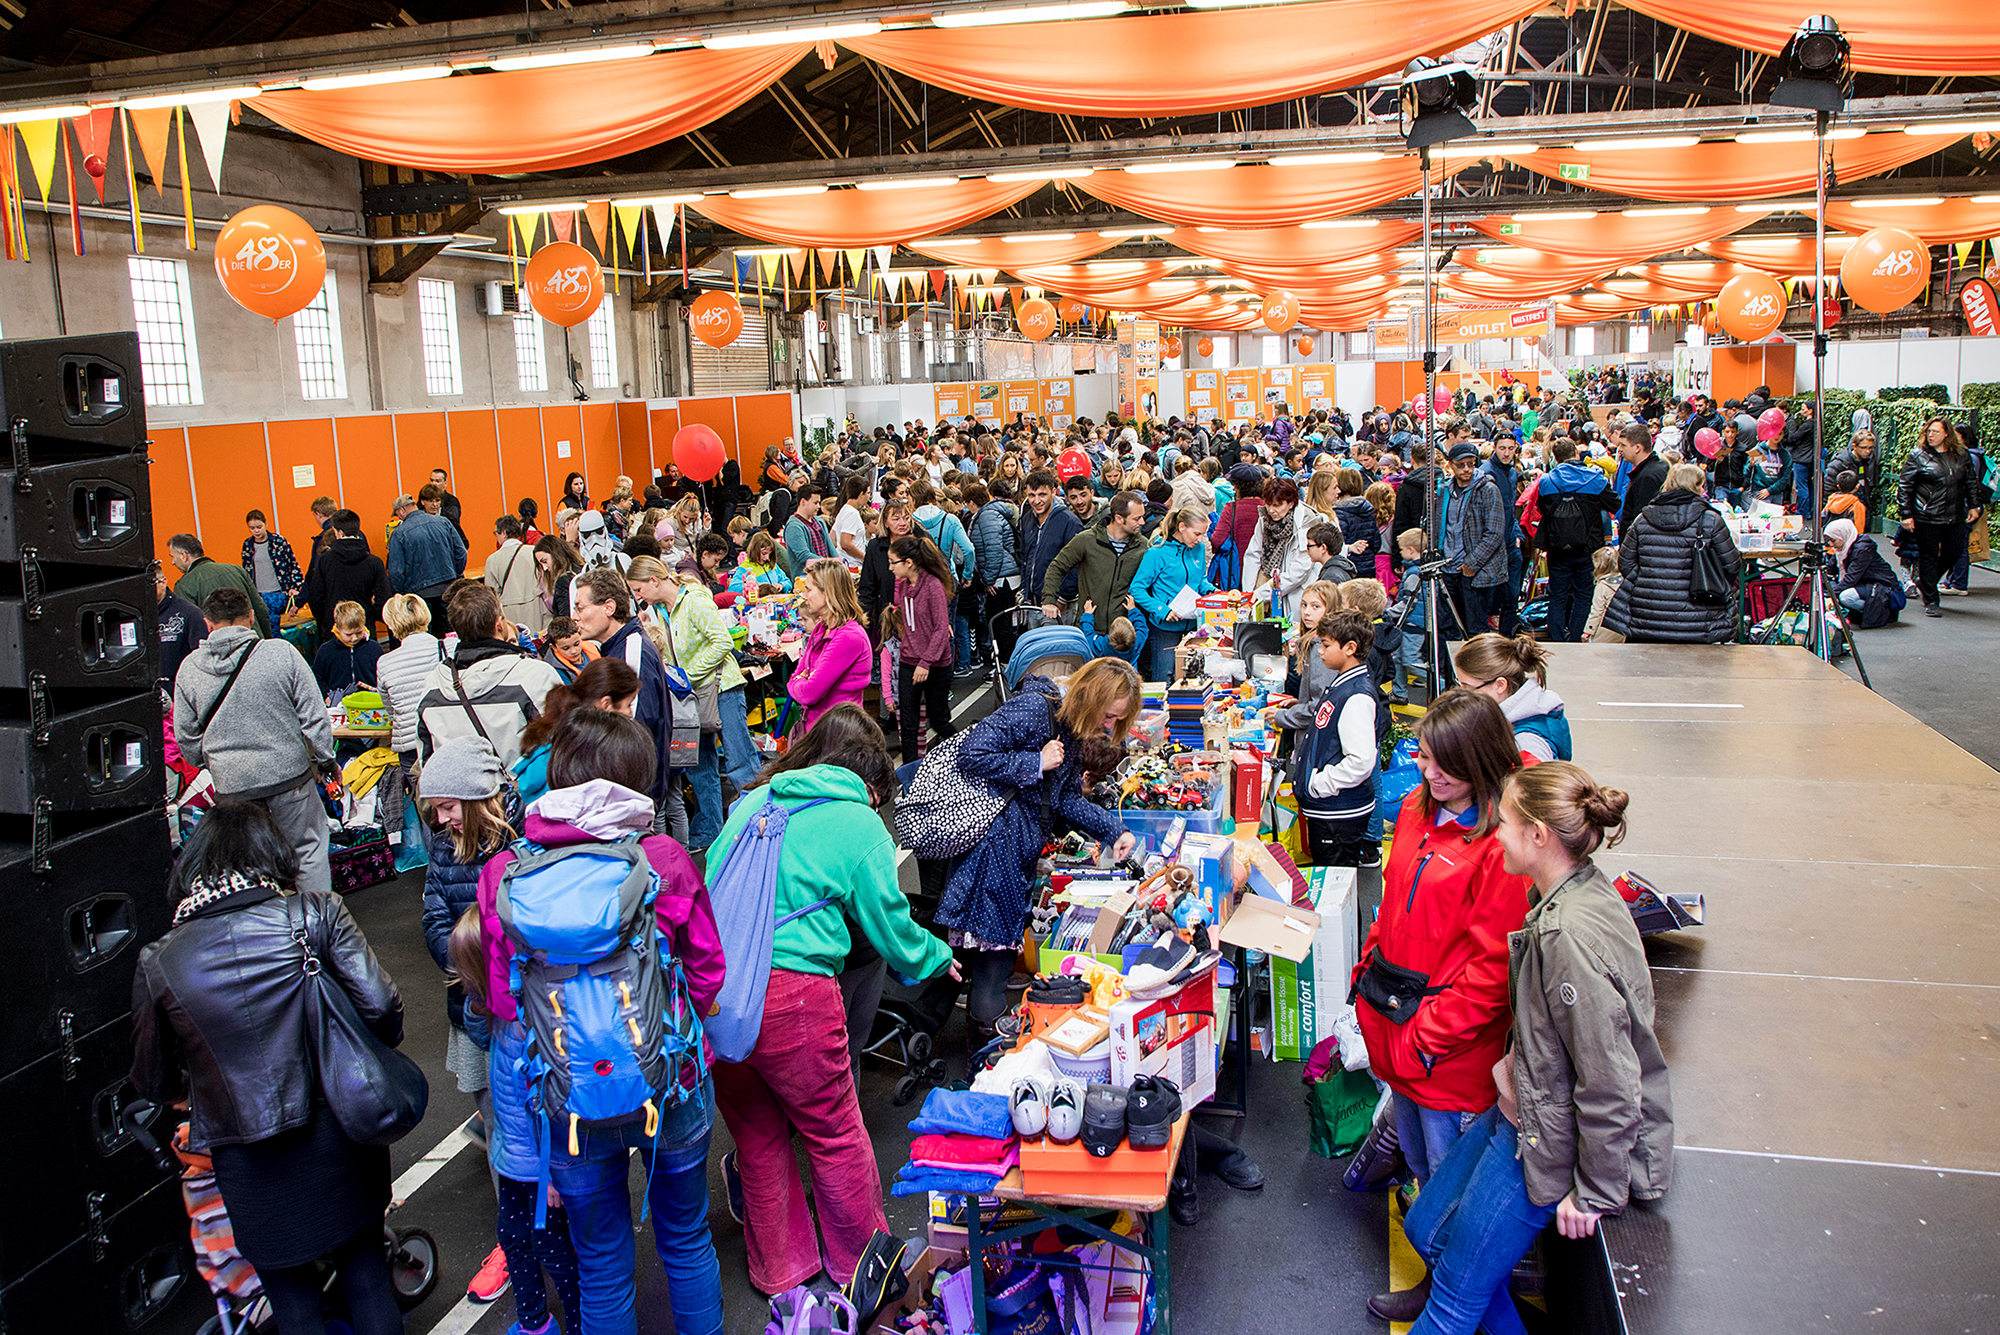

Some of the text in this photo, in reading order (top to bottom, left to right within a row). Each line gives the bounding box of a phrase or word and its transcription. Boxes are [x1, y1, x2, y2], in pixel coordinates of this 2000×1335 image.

[1512, 310, 1546, 325] MISTFEST
[1459, 322, 1506, 337] OUTLET
[1278, 976, 1286, 997] tissue
[1279, 999, 1287, 1022] towels
[1299, 980, 1315, 1032] comfort
